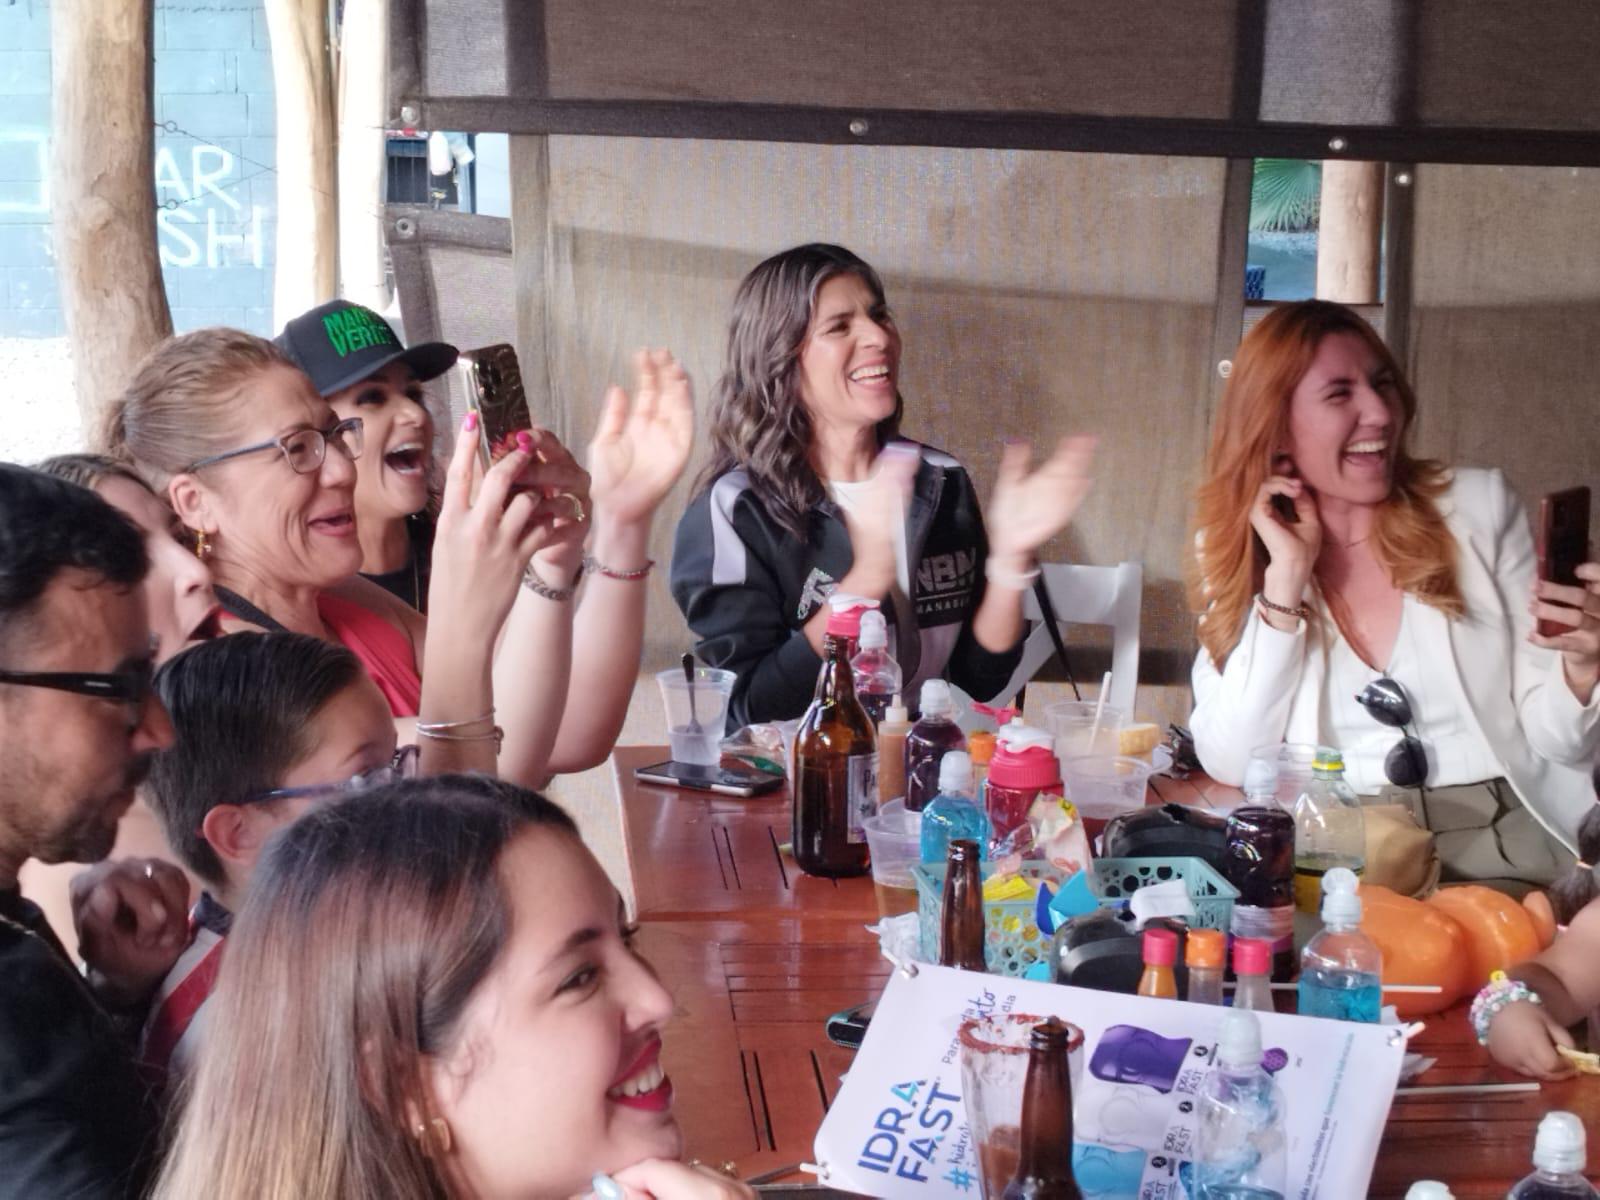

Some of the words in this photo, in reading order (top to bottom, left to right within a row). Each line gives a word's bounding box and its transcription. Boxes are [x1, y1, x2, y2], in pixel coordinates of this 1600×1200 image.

[154, 145, 241, 210] AR
[157, 206, 263, 269] SH
[857, 1079, 928, 1174] IDRA
[895, 1081, 962, 1183] FAST
